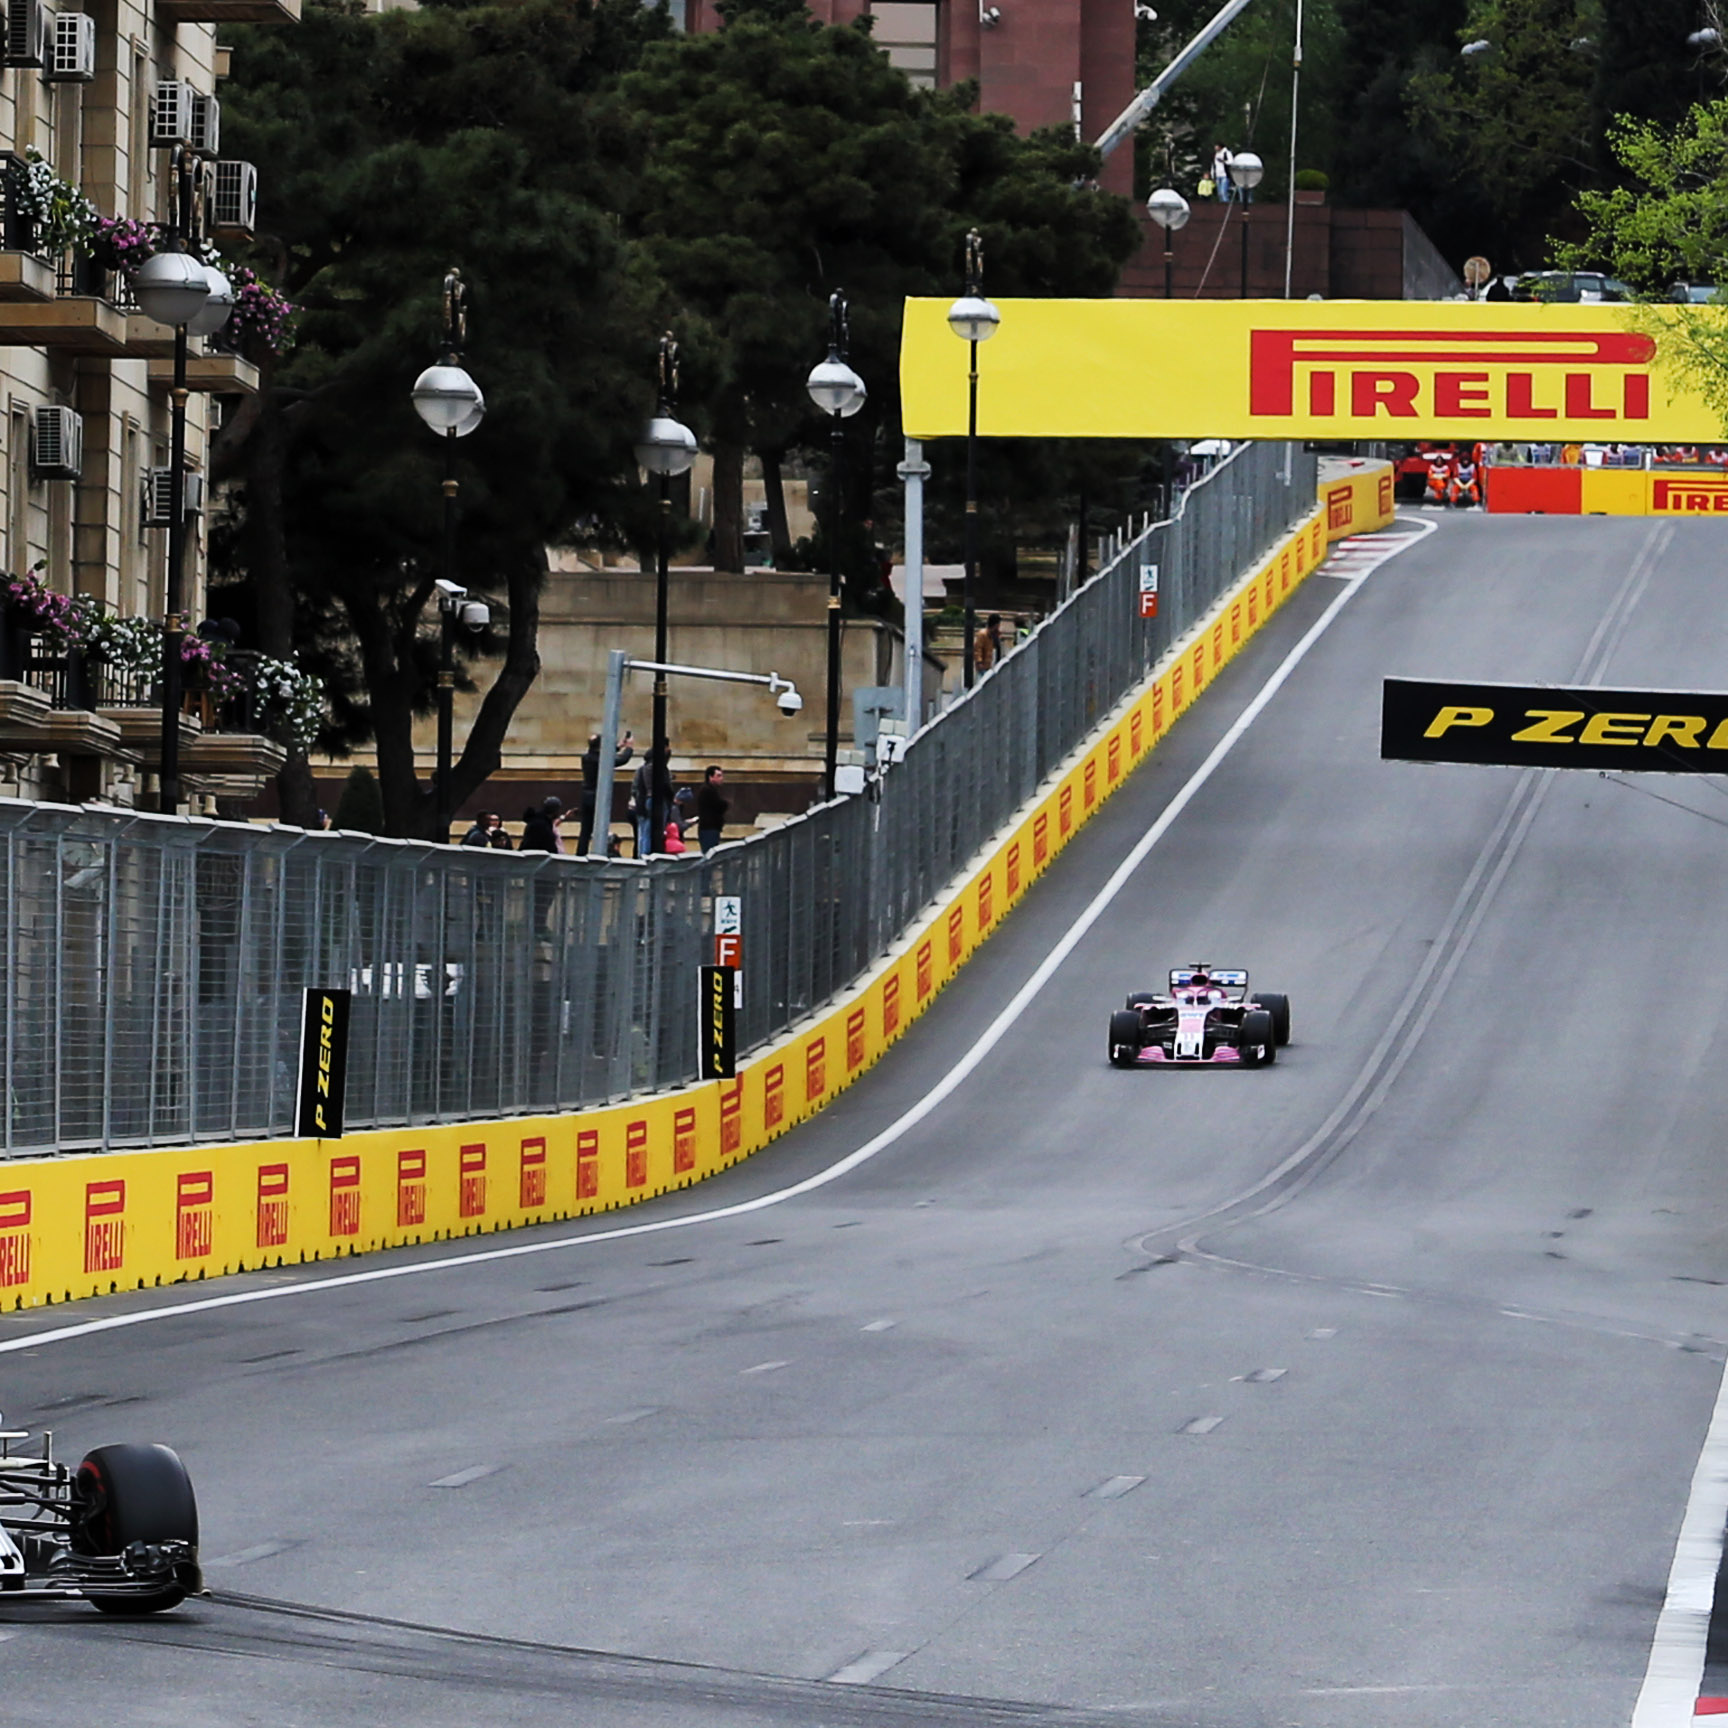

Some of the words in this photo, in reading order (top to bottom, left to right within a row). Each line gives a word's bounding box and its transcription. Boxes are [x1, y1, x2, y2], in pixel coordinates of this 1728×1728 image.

[1250, 329, 1658, 420] PIRELLI
[1142, 594, 1155, 614] F
[1423, 706, 1494, 738] P
[719, 938, 737, 966] F
[318, 996, 334, 1098] ZERO
[713, 972, 723, 1048] ZERO
[315, 1104, 327, 1130] P
[84, 1180, 125, 1273] PIRELLI
[176, 1171, 213, 1259] PIRELLI
[257, 1164, 288, 1247] PIRELLI
[330, 1156, 360, 1236] PIRELLI
